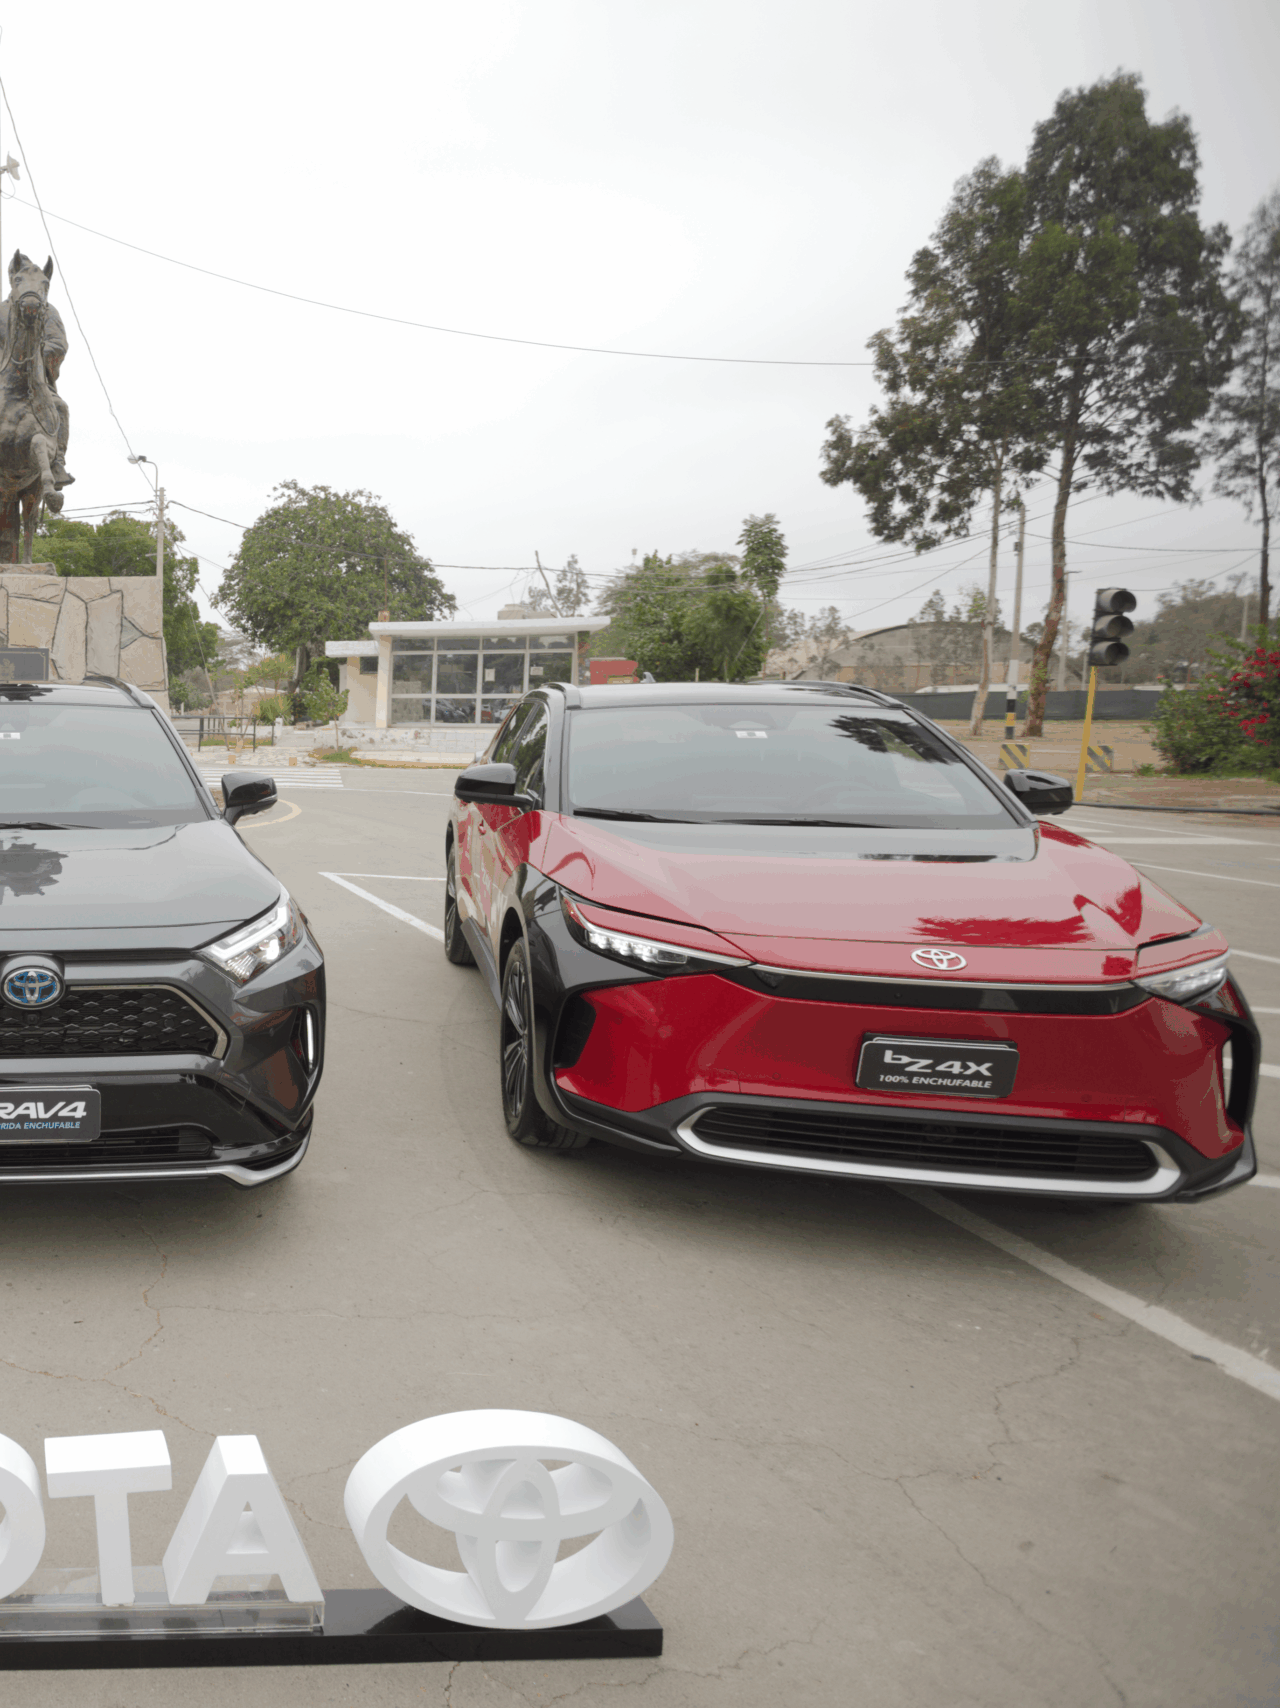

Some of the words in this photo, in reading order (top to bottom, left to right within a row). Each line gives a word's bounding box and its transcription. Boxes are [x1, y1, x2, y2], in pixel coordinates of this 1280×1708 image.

[879, 1074, 909, 1084] 100%
[912, 1076, 993, 1089] ENCHUFABLE
[24, 1121, 81, 1130] ENCHUFABLE
